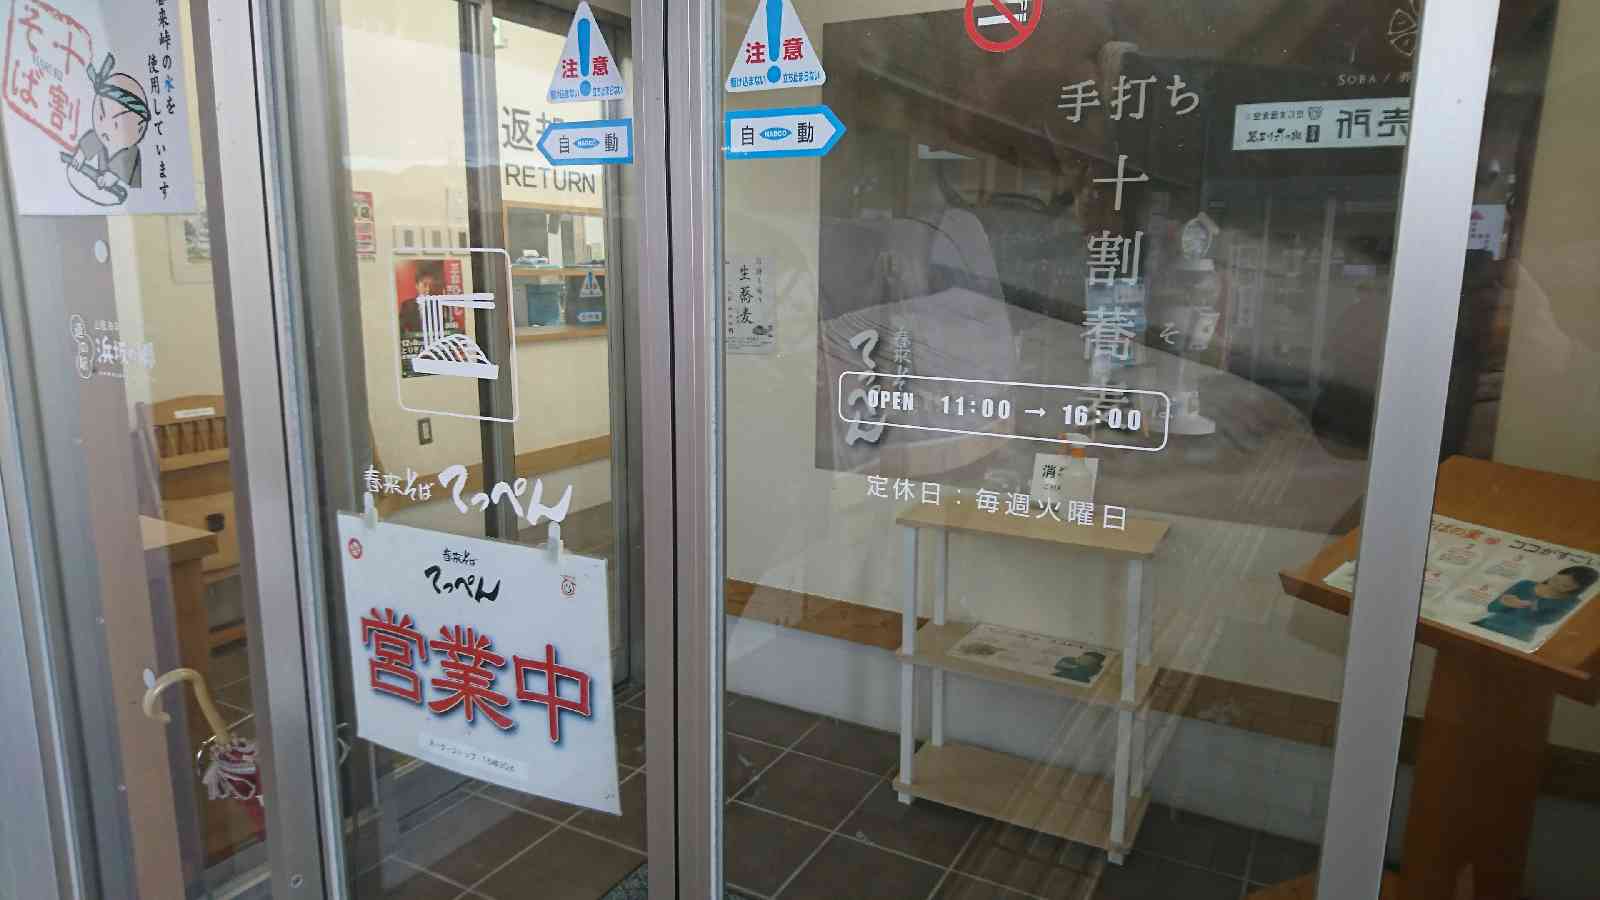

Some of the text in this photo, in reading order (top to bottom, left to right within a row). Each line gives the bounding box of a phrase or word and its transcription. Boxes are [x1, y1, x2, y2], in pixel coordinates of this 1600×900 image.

[12, 4, 44, 111] そば
[48, 30, 86, 141] 十割
[1057, 74, 1200, 123] 手打ち
[148, 54, 171, 201] 使用しています
[501, 105, 564, 152] 返
[504, 163, 596, 194] RETURN
[867, 390, 914, 411] OPEN
[941, 395, 1013, 420] 11:00
[1061, 404, 1142, 431] 16:00
[361, 464, 573, 526] 春来そば てっぺん
[423, 564, 501, 603] てっぺん
[360, 606, 594, 744] 営業中
